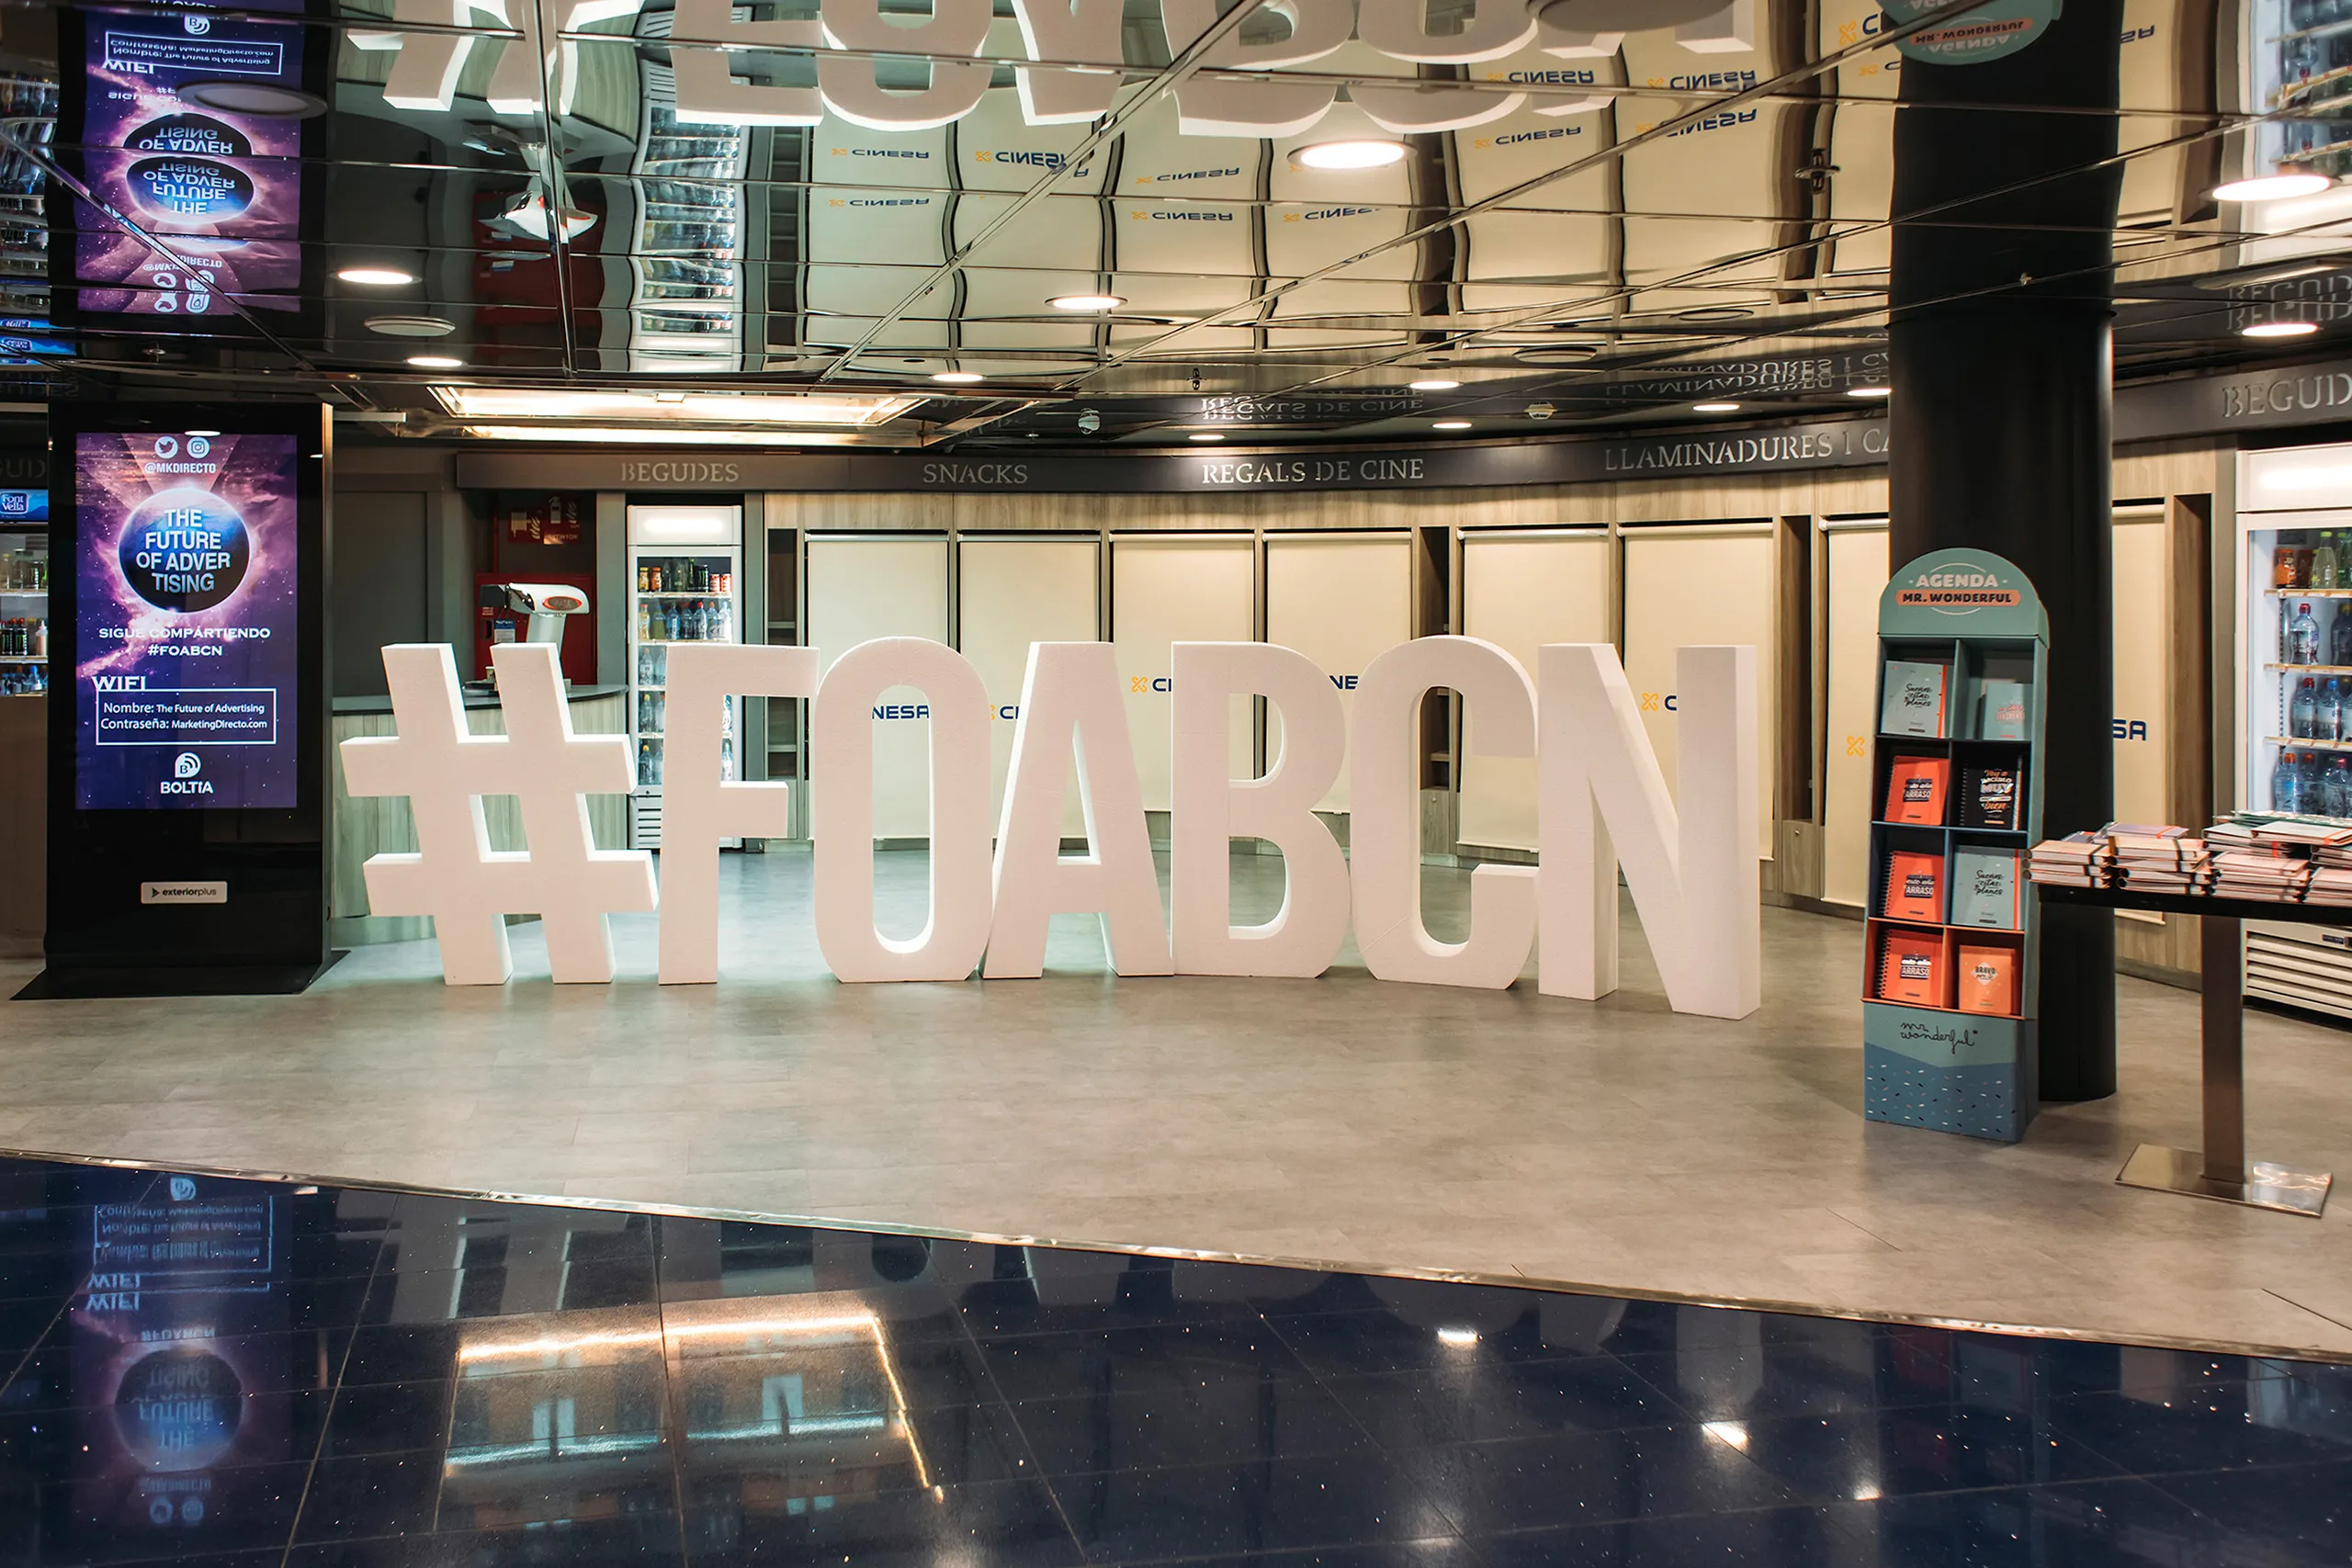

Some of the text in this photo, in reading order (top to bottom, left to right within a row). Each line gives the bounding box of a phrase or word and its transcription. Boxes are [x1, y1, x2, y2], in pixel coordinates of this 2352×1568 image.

[2222, 373, 2352, 417] BEGUD
[1605, 432, 1833, 470] LLAMINADURES
[144, 462, 217, 474] @MKDIRECTO
[621, 463, 739, 482] BEGUDES
[923, 463, 1028, 483] SNACKS
[1202, 459, 1423, 483] REGALS DE CINE
[2, 494, 24, 503] Font
[1, 502, 25, 511] Vella
[164, 509, 202, 527] THE
[145, 531, 221, 549] FUTURE
[135, 551, 231, 571] OF ADVER
[152, 572, 214, 593] TISING
[1916, 574, 1998, 587] AGENDA
[1903, 592, 2011, 604] MR. WONDERFUL
[98, 627, 271, 638] SIGUE COMPARTIENDO
[147, 644, 223, 656] #FOABCN
[92, 676, 146, 690] WIFI
[104, 702, 265, 715] Nombre: The Future of Advertising
[872, 705, 929, 719] NESA
[100, 717, 267, 731] Contraseña: MarketingDirecto.com
[160, 781, 214, 794] BOLTIA
[340, 635, 1760, 1019] #FOABCN
[162, 887, 217, 897] exteriorplus
